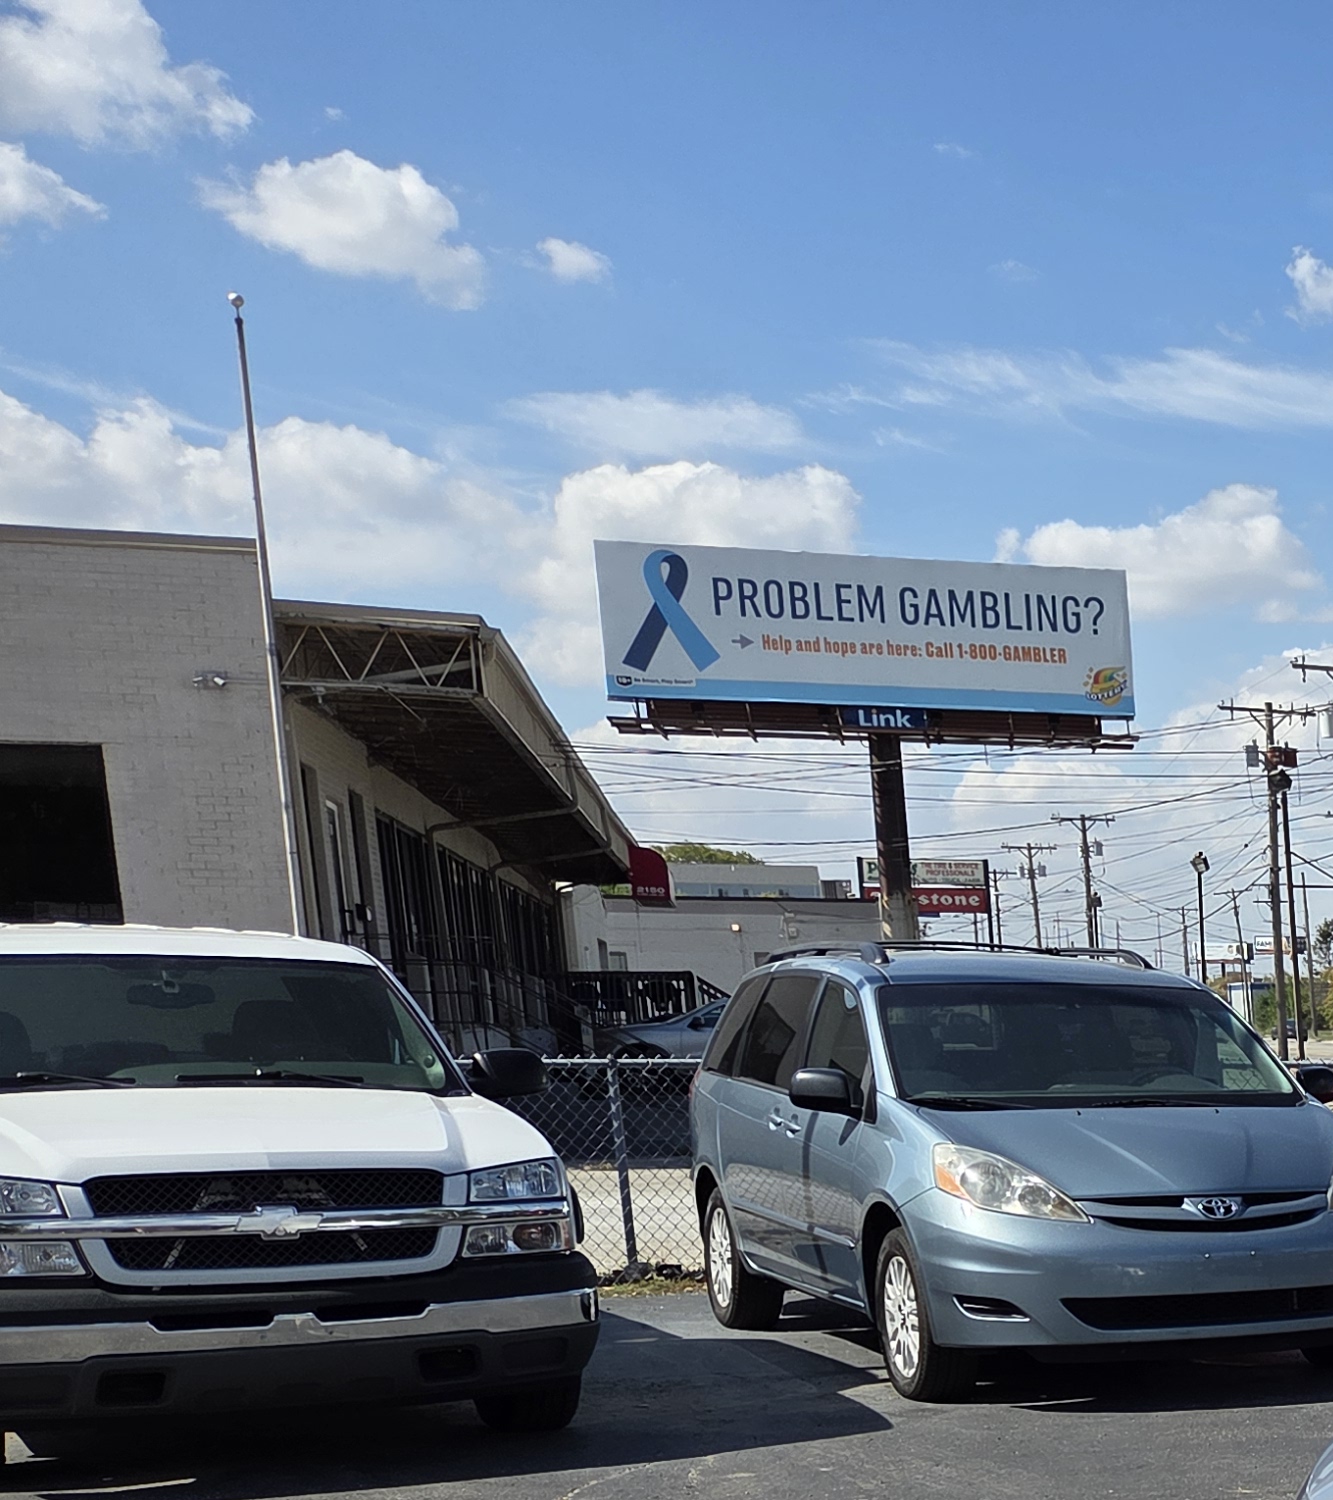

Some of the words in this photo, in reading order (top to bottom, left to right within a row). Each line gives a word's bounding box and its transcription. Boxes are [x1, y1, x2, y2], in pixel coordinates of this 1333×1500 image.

[712, 576, 886, 624] PROBLEM
[899, 586, 1105, 636] GAMBLING?
[761, 633, 792, 655] Help
[796, 636, 821, 653] and
[824, 637, 857, 658] hope
[860, 641, 883, 656] are
[886, 639, 922, 658] here:
[925, 641, 954, 659] Call
[956, 642, 1068, 665] 1-800-GAMBLER
[858, 708, 912, 728] Link
